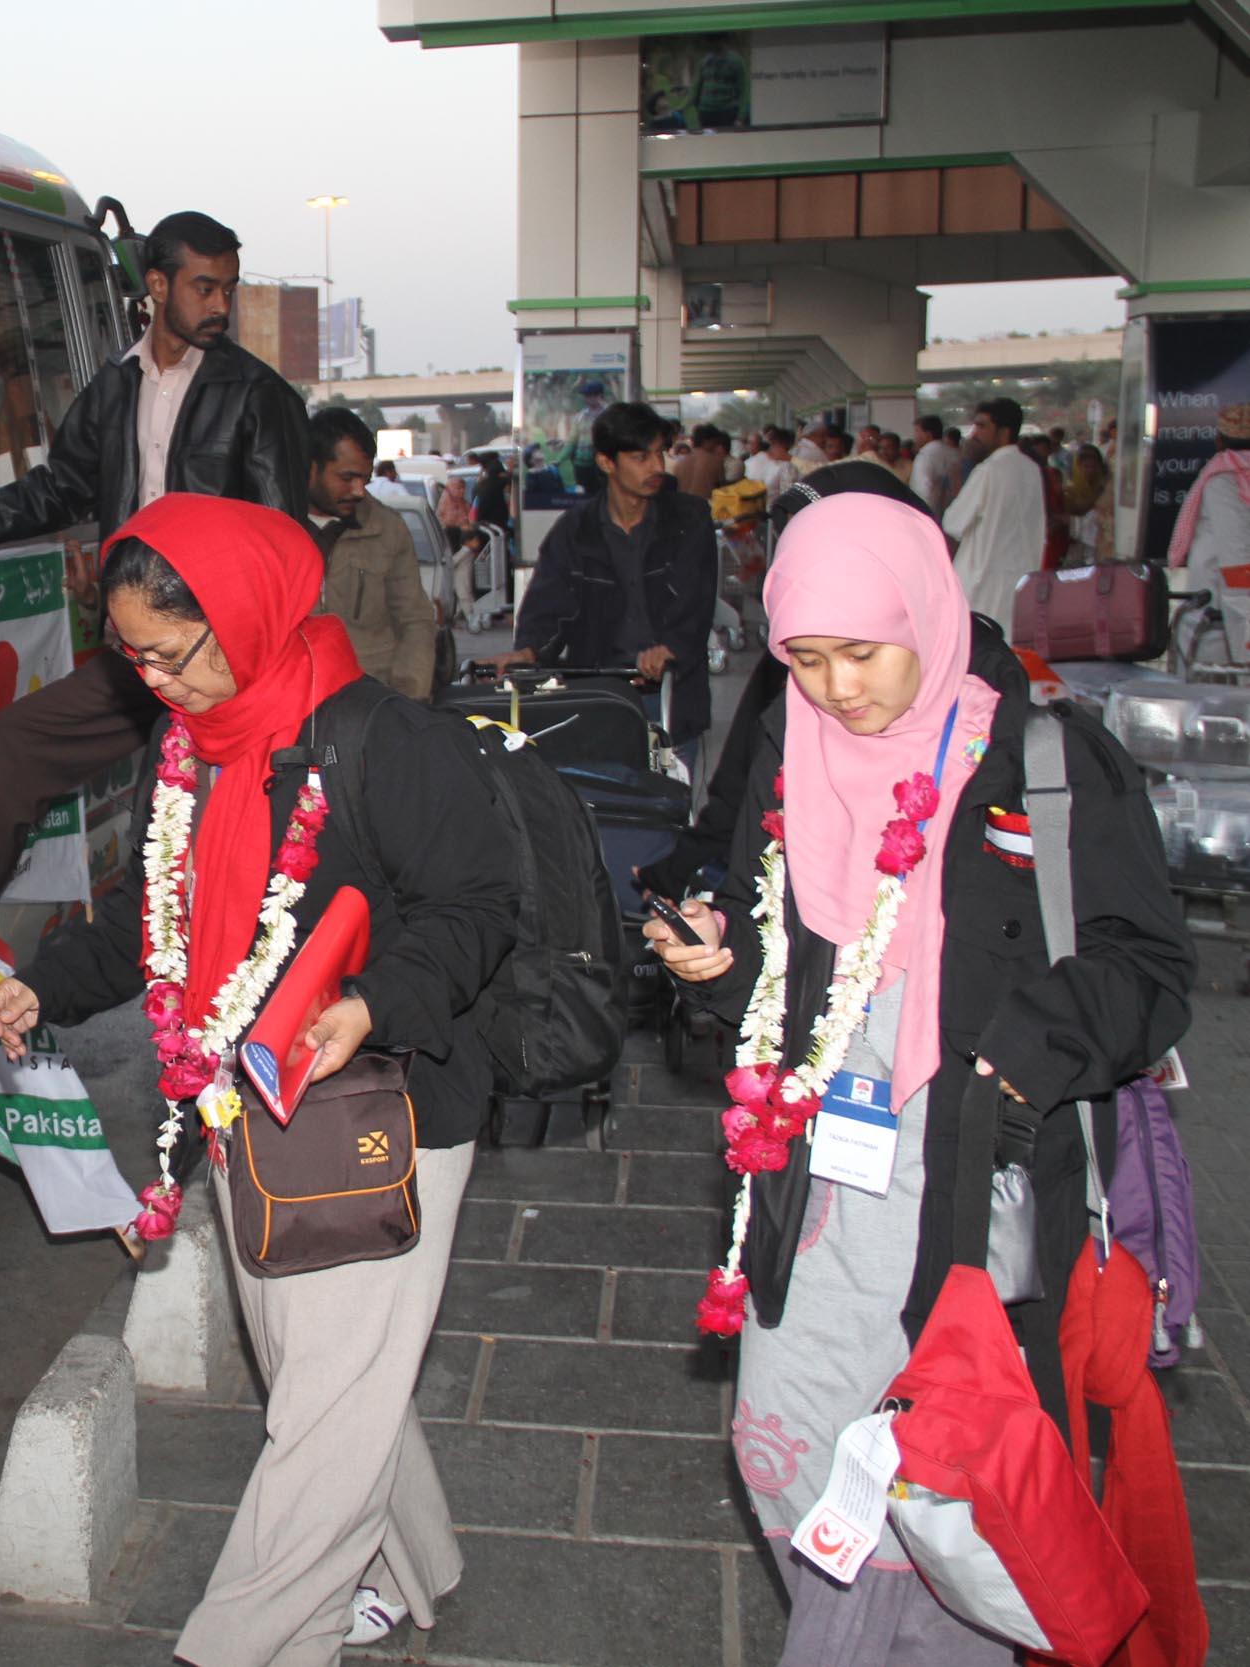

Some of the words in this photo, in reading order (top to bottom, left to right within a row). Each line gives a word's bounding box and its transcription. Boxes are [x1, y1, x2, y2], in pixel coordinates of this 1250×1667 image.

[1158, 391, 1218, 409] When
[1156, 458, 1201, 478] your
[5, 1107, 104, 1138] Pakista
